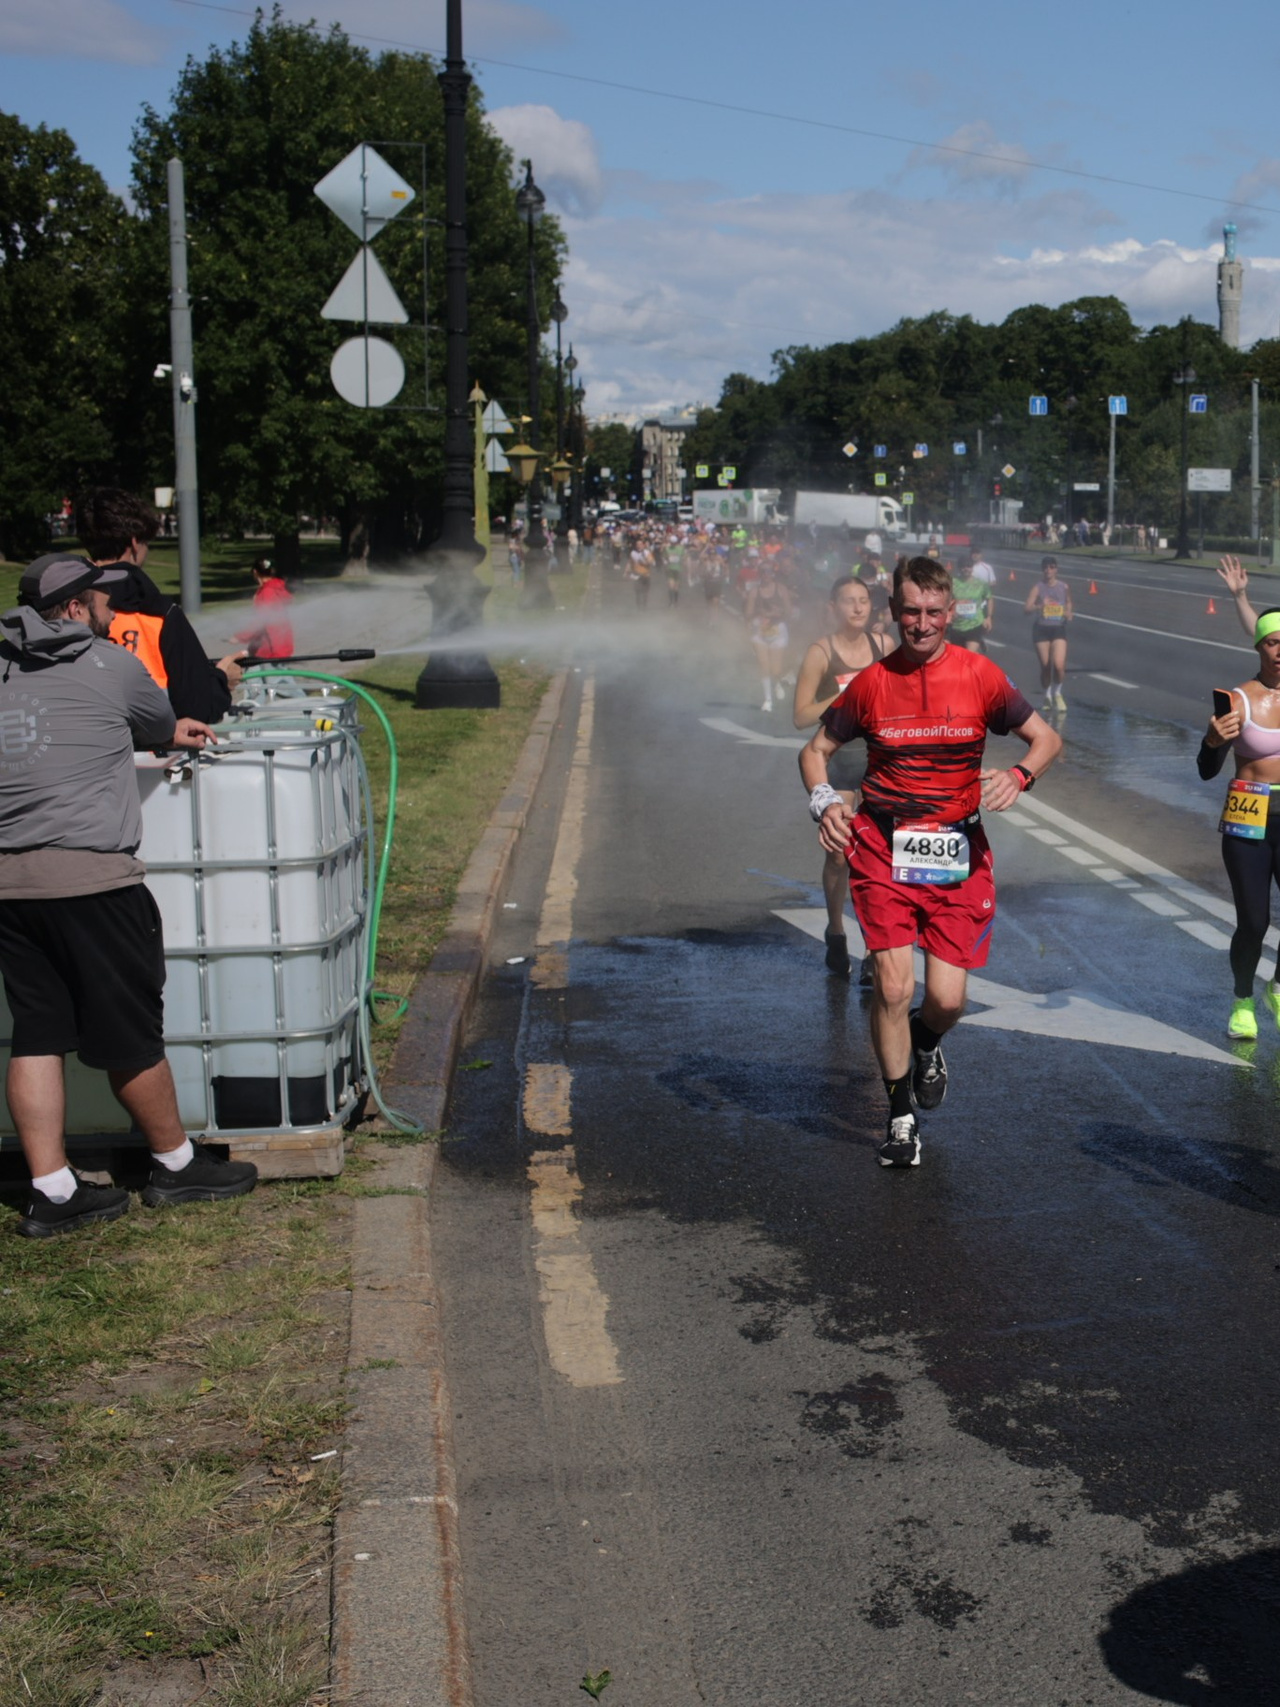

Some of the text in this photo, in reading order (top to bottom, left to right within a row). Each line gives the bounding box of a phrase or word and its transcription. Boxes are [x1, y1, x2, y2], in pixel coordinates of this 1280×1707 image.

[878, 725, 974, 738] #БеговойПсков
[903, 836, 960, 858] 4830
[909, 857, 953, 866] АЛЕКСАНДР
